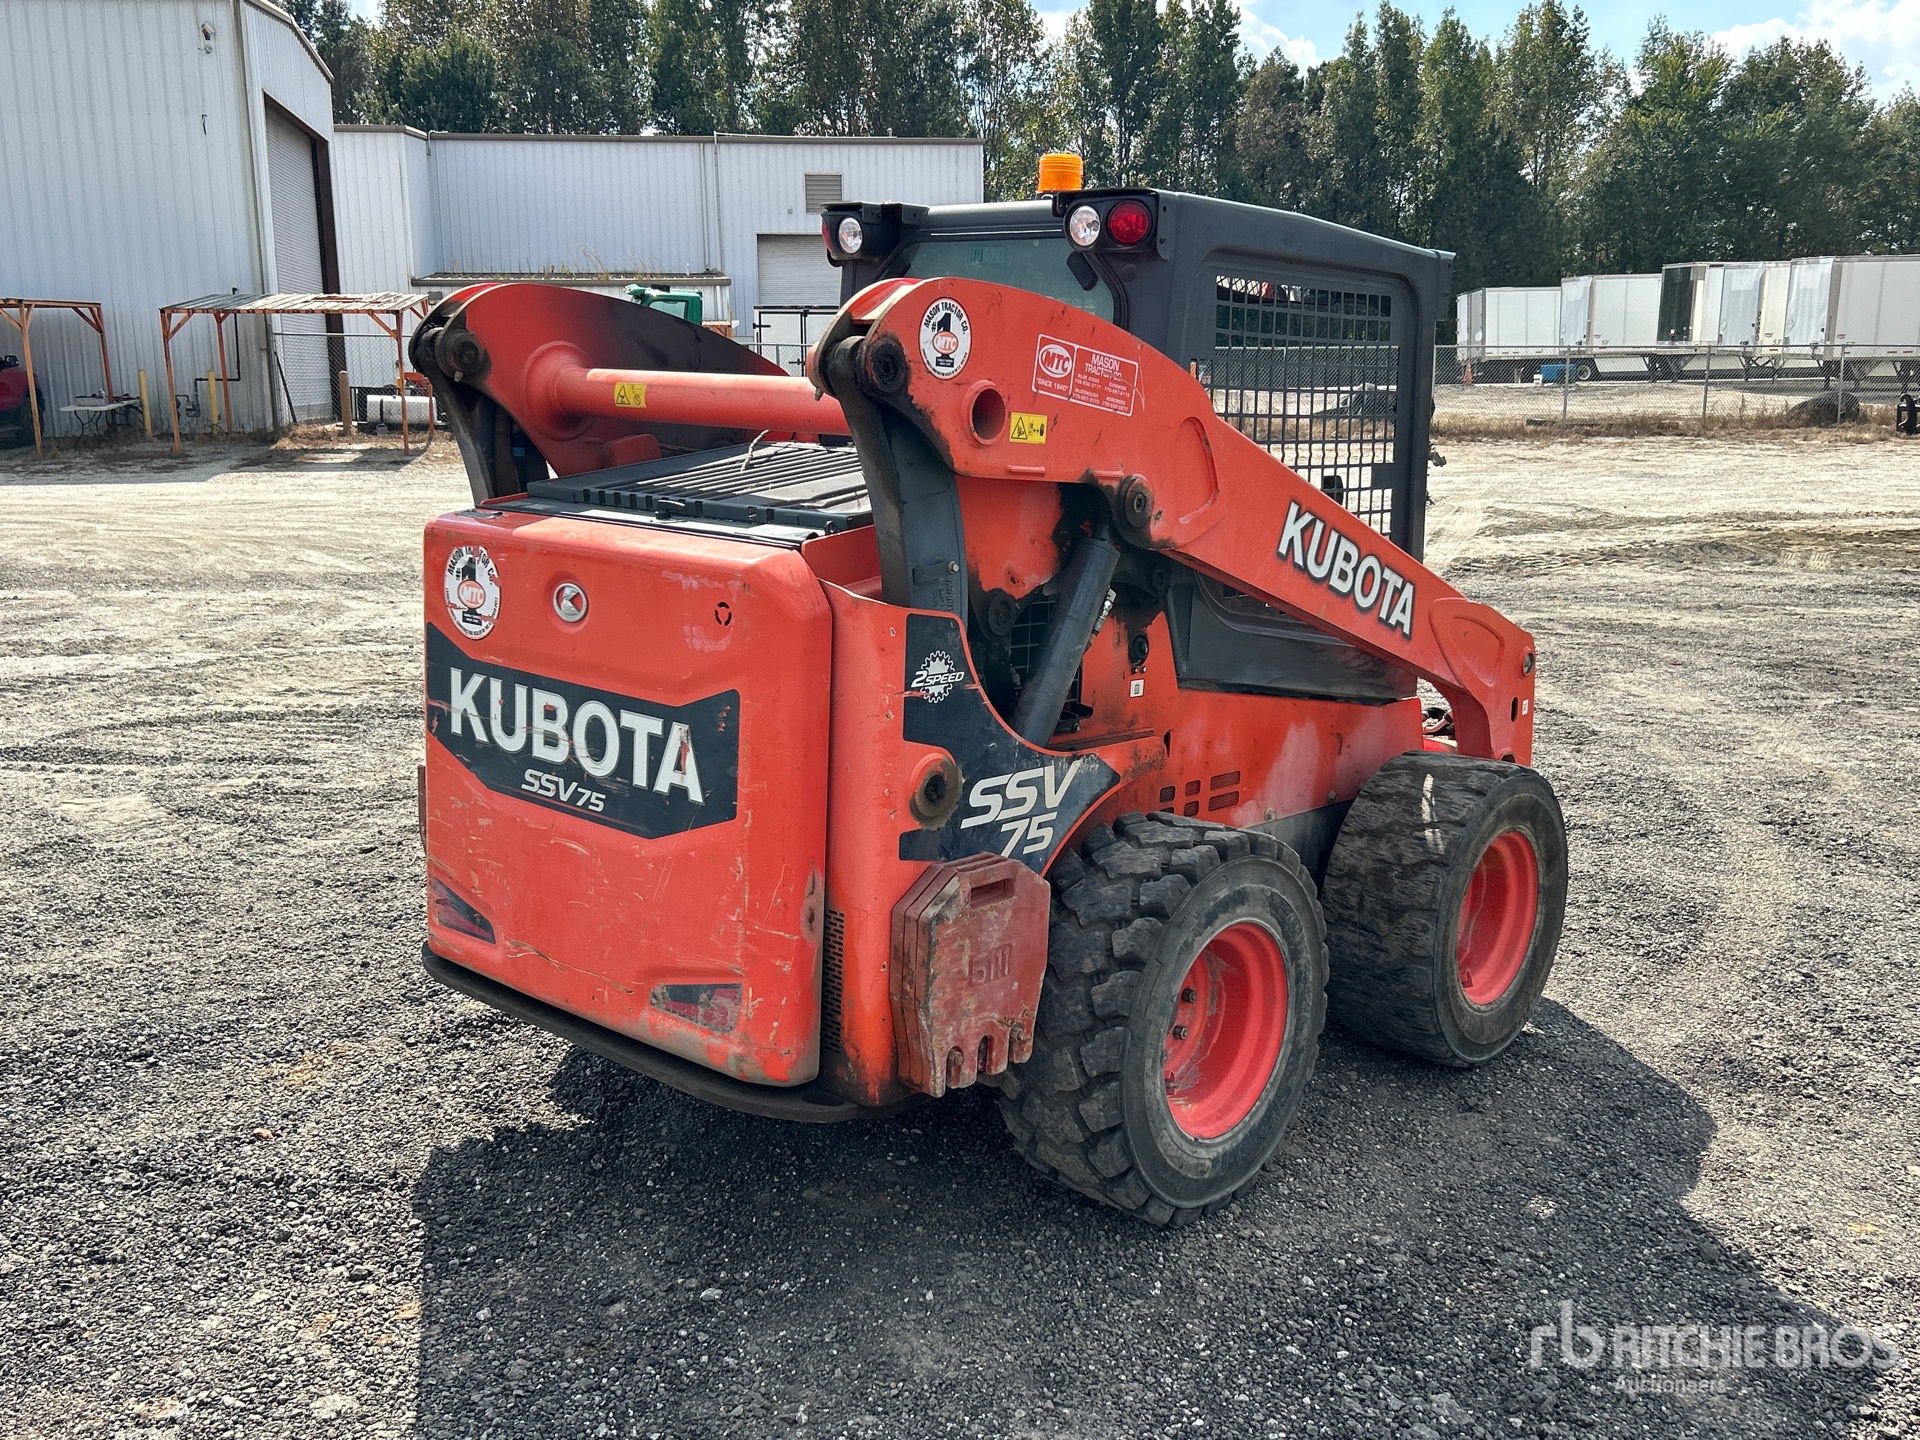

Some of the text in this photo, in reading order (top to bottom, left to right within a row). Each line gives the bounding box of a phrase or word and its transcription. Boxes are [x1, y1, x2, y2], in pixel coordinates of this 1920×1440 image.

[923, 303, 941, 328] MASON
[941, 301, 964, 321] TRACTOR
[935, 336, 957, 350] MTC
[1042, 350, 1070, 373] MTC
[1091, 354, 1120, 372] MASON
[447, 547, 464, 576] MASON
[465, 545, 490, 568] TRTOR
[1277, 501, 1415, 636] KUBOTA
[462, 586, 485, 605] MTC
[450, 666, 705, 806] KUBOTA
[960, 760, 1083, 829] SSV
[1000, 811, 1058, 858] 75
